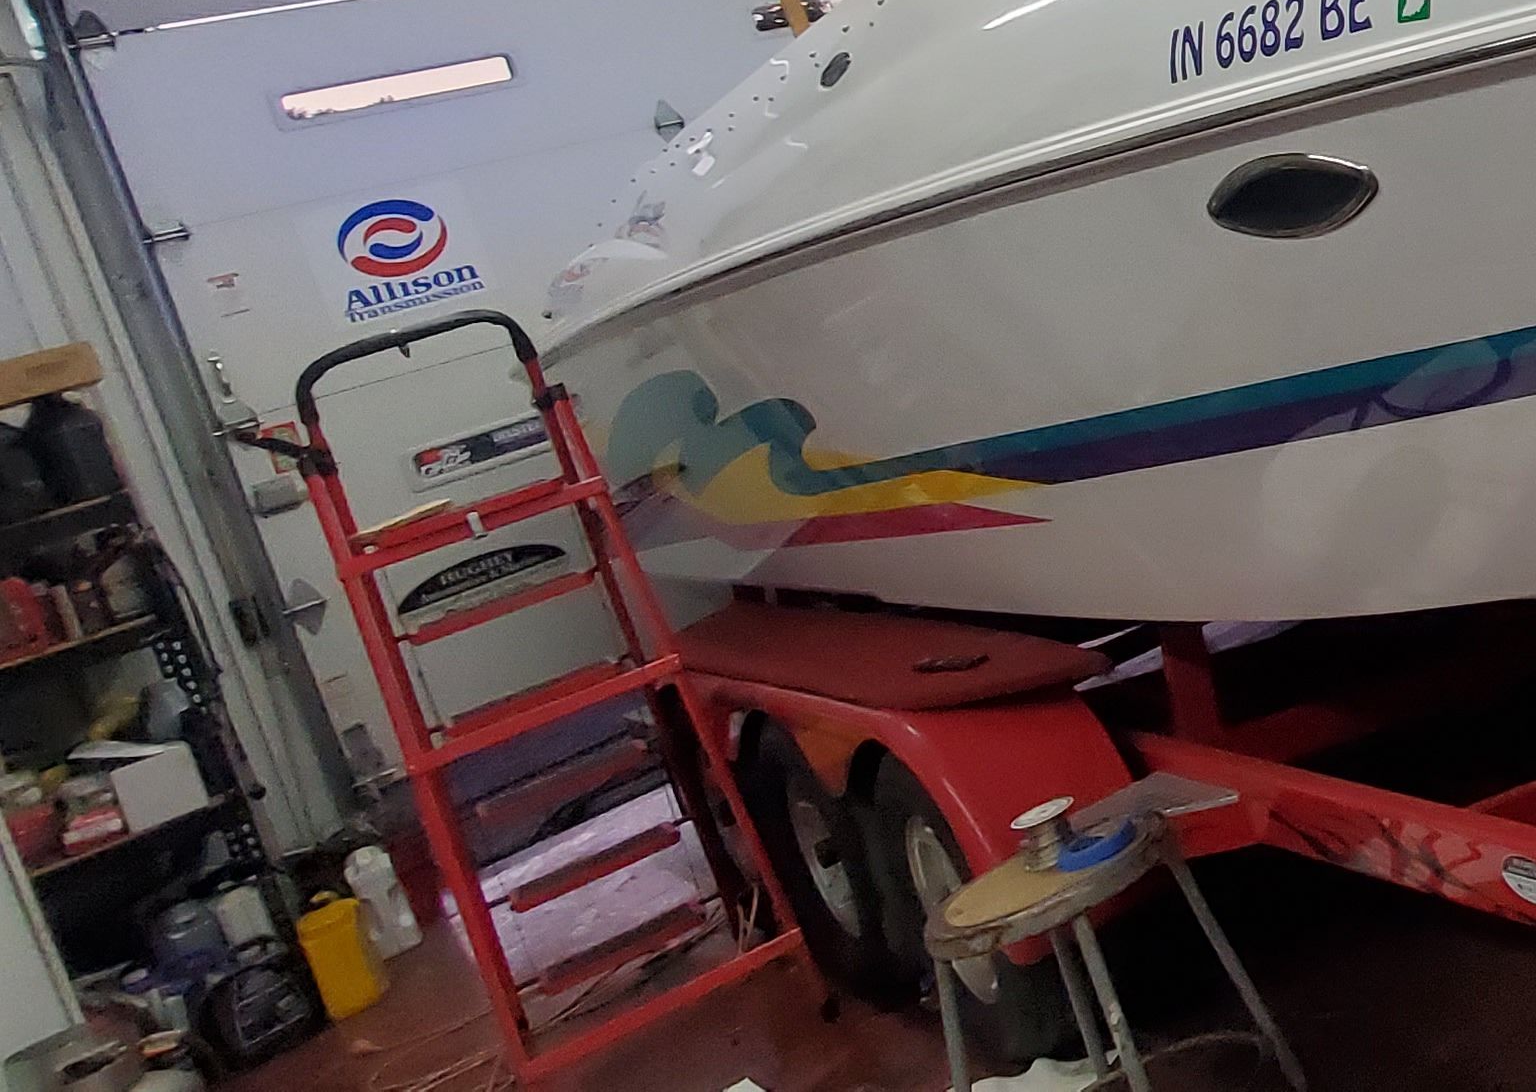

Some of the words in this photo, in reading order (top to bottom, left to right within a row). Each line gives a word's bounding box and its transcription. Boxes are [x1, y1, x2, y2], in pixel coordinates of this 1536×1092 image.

[1169, 20, 1204, 84] IN
[345, 281, 486, 323] Transmission
[346, 264, 481, 311] Allison
